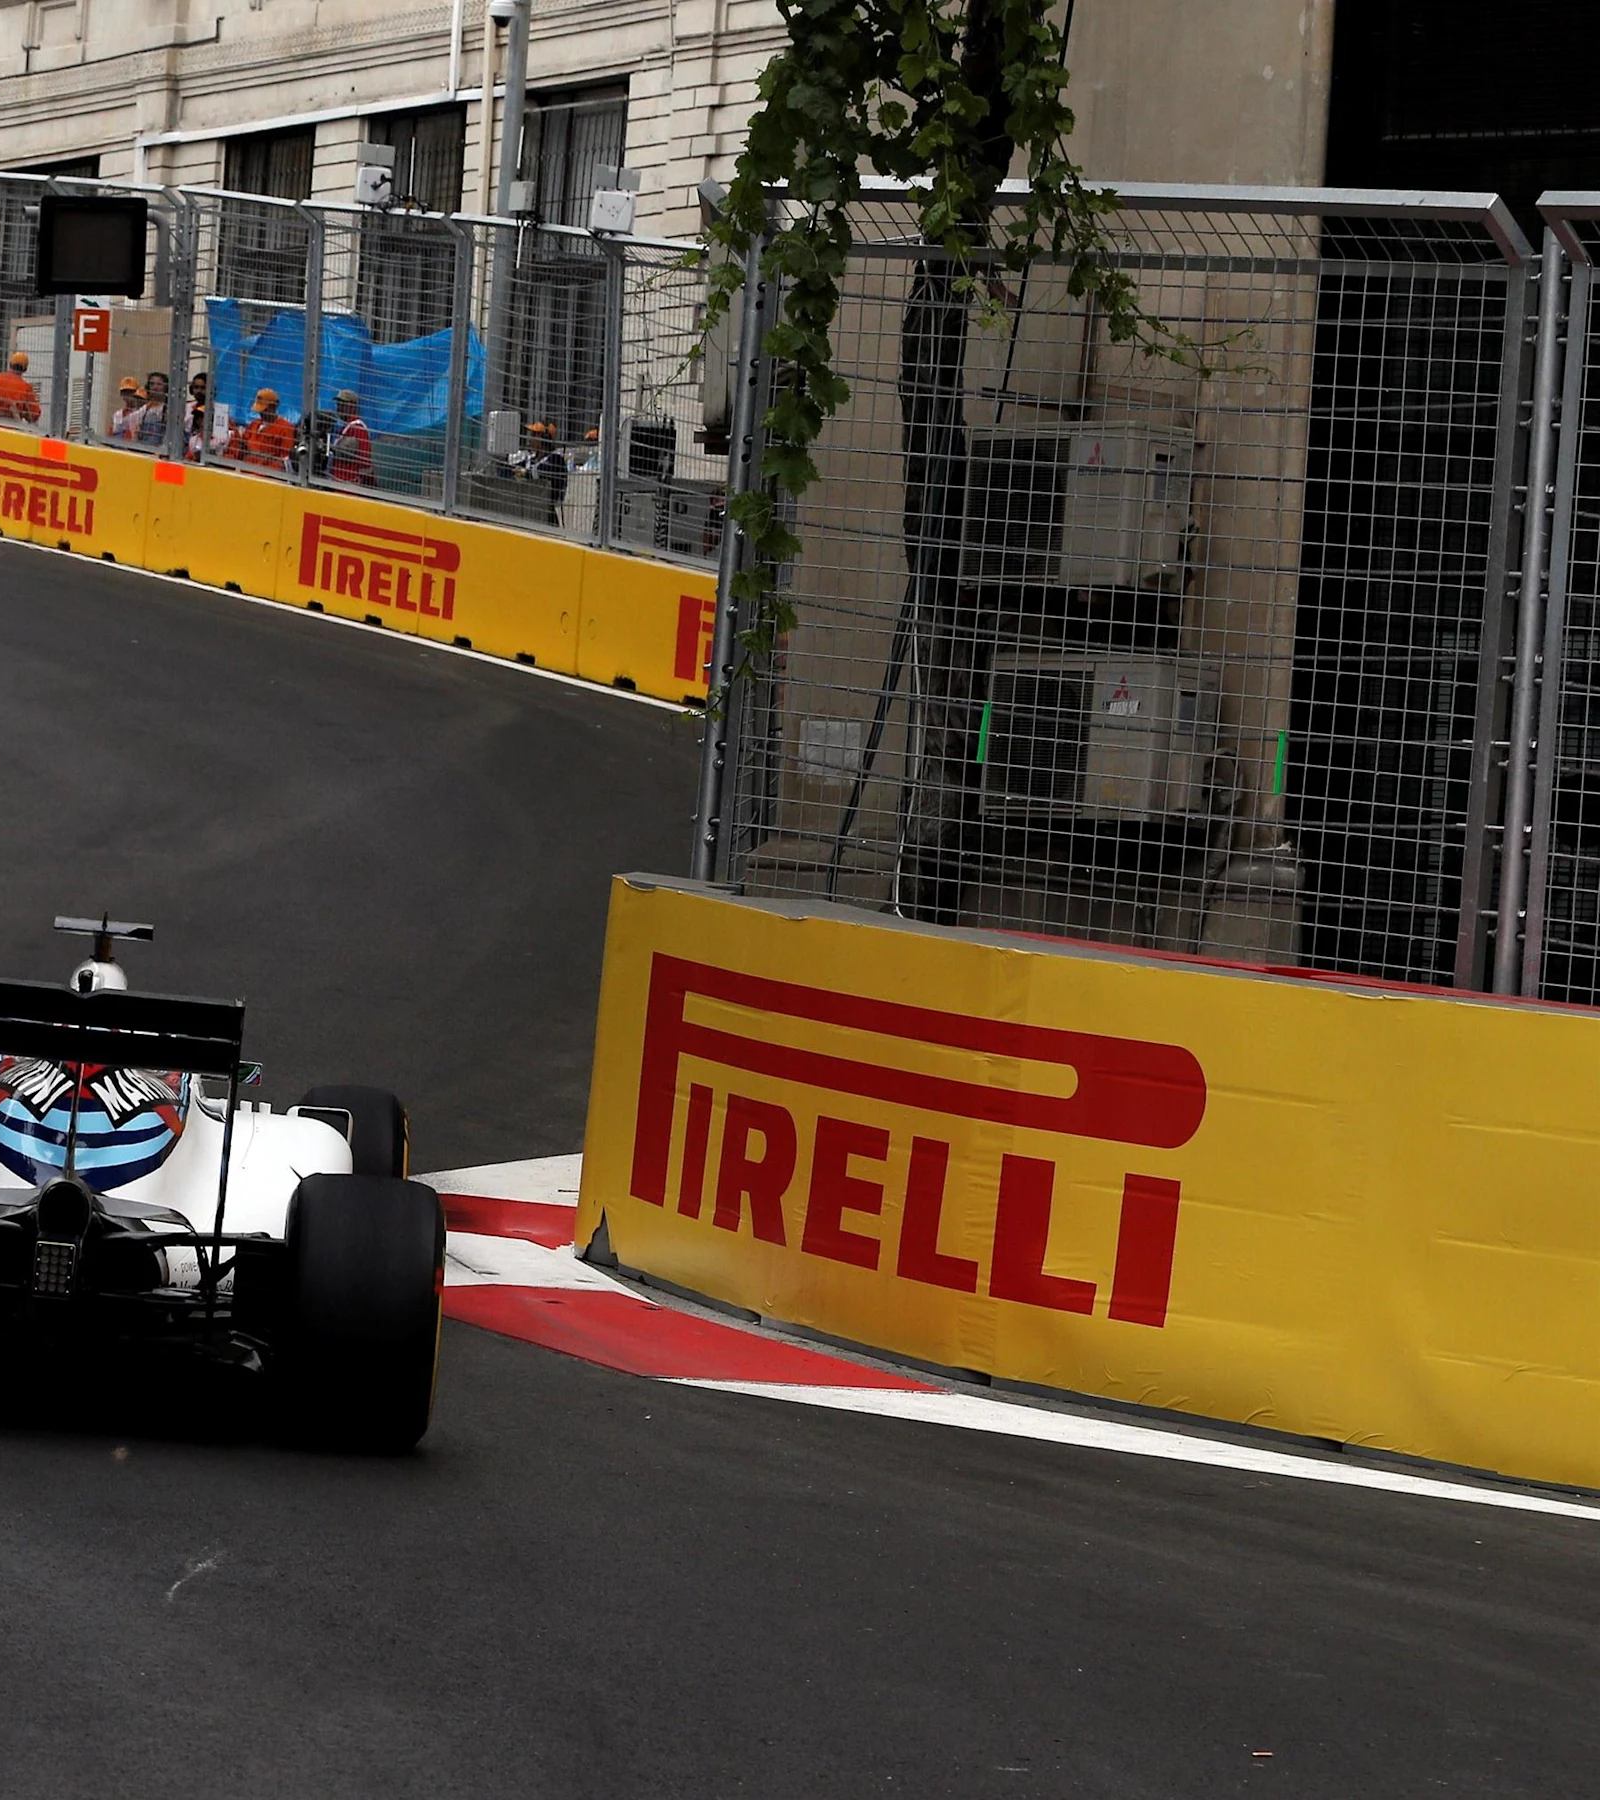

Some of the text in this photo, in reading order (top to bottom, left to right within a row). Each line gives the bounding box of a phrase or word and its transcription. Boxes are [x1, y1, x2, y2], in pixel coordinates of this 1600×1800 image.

[78, 314, 100, 346] F
[298, 512, 460, 620] PIRELLI
[630, 952, 1207, 1328] PIRELLI
